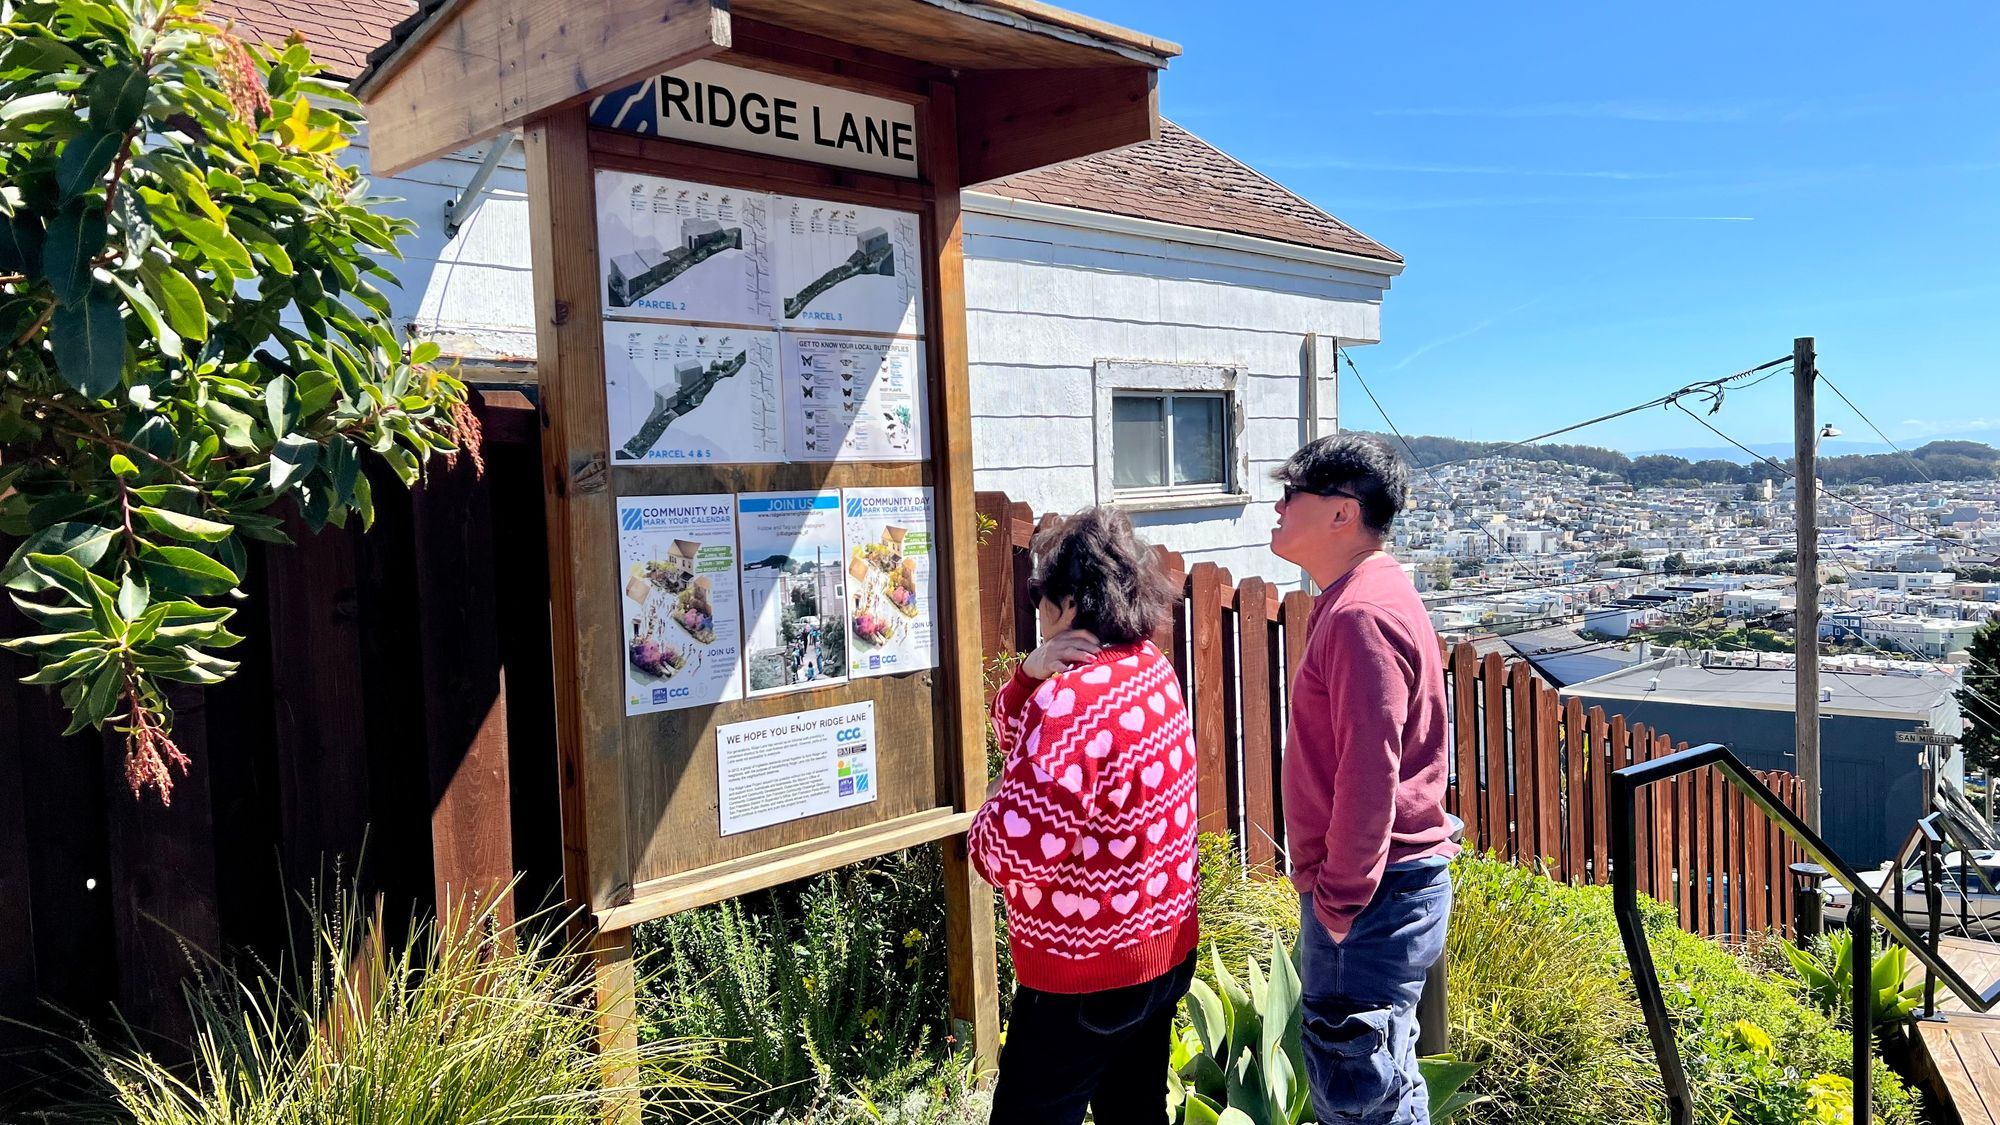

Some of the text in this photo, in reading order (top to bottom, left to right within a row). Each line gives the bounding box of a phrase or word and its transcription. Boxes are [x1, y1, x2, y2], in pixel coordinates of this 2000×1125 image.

[660, 74, 914, 161] RIDGE LANE
[638, 300, 686, 311] PARCEL 2
[802, 311, 843, 321] PARCEL 3
[820, 341, 838, 349] KNOW
[839, 342, 854, 350] YOUR
[874, 344, 910, 353] BUTTERFLIES
[649, 449, 711, 459] PARCEL 4 & 5
[767, 498, 814, 511] JOIN US
[862, 496, 930, 506] COMMUNITY DAY
[642, 506, 730, 518] COMMUNITY DAY
[643, 515, 731, 526] MARK YOUR CALENDAR
[707, 649, 724, 657] JOIN
[882, 654, 897, 664] CCG
[669, 687, 689, 697] CCG
[727, 712, 867, 744] WE HOPE YOU ENJOY RIDGE LANE
[837, 727, 861, 742] CCG
[1899, 734, 1950, 744] SAN MIGUEL
